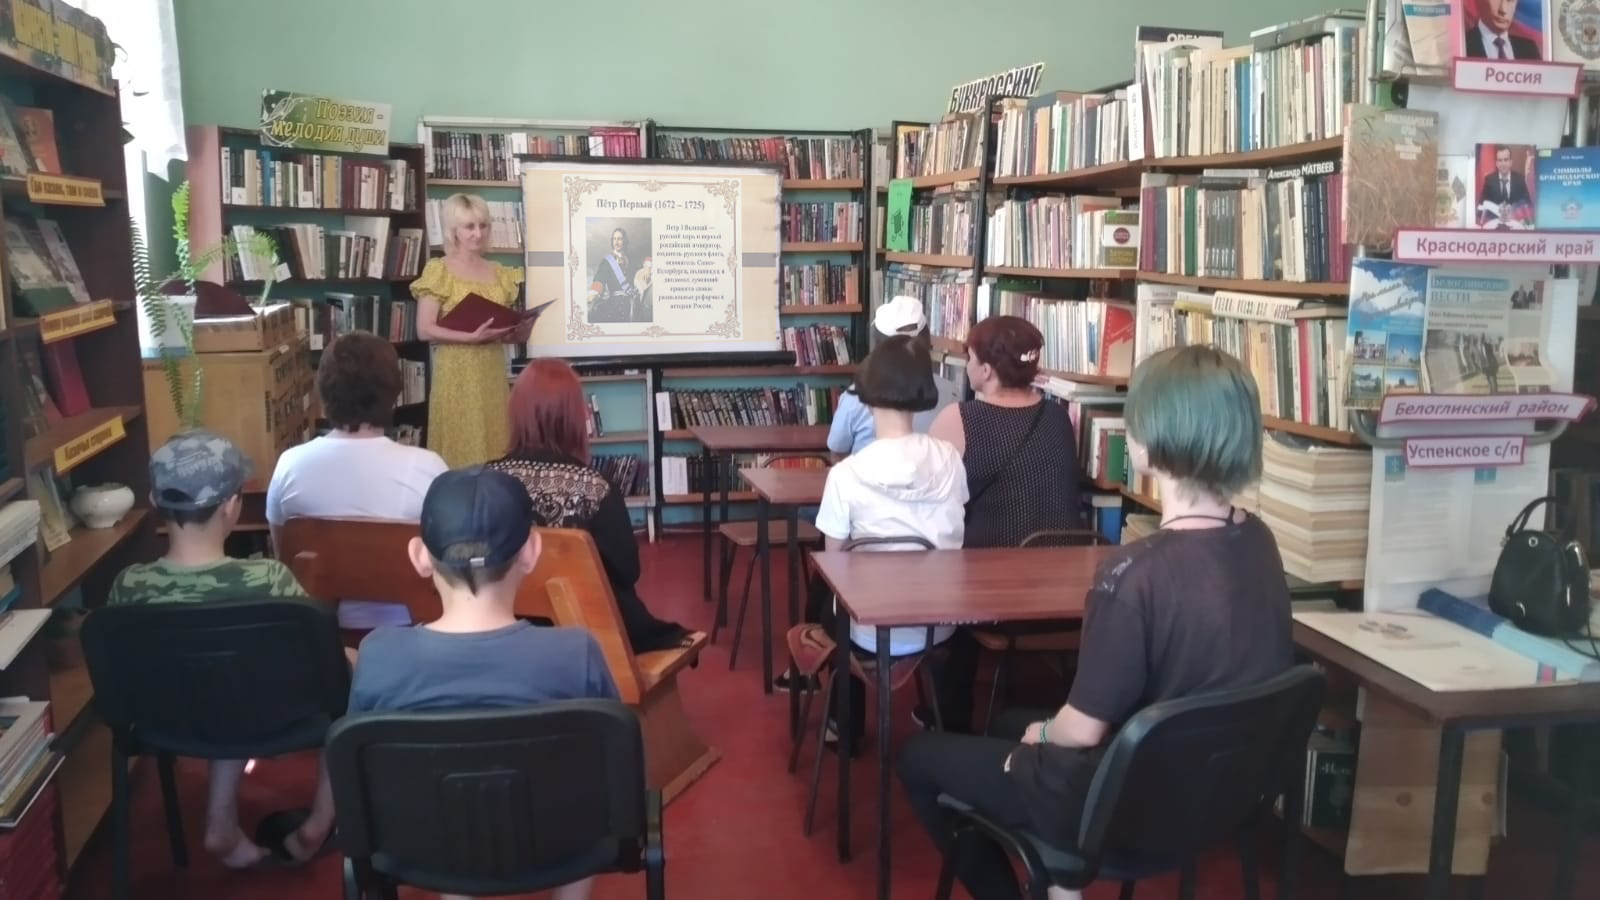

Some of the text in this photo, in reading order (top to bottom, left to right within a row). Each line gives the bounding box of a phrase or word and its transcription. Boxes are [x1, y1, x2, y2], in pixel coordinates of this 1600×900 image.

[1485, 67, 1542, 84] Россия
[949, 64, 1043, 113] БУККРОССИНГ
[315, 98, 375, 124] Поэзия
[271, 119, 386, 152] мелодия души
[1267, 161, 1334, 179] Александр МАТВЕЕВ
[596, 199, 617, 210] Пётр
[619, 199, 652, 210] Первый
[654, 200, 676, 210] (1672
[684, 200, 705, 210] 1725)
[659, 241, 691, 249] российский
[701, 233, 722, 241] первый
[1416, 238, 1594, 257] Краснодарский край
[695, 294, 720, 302] реформы
[1395, 400, 1569, 416] Белоглинский район
[1408, 440, 1519, 459] Успенское с/п
